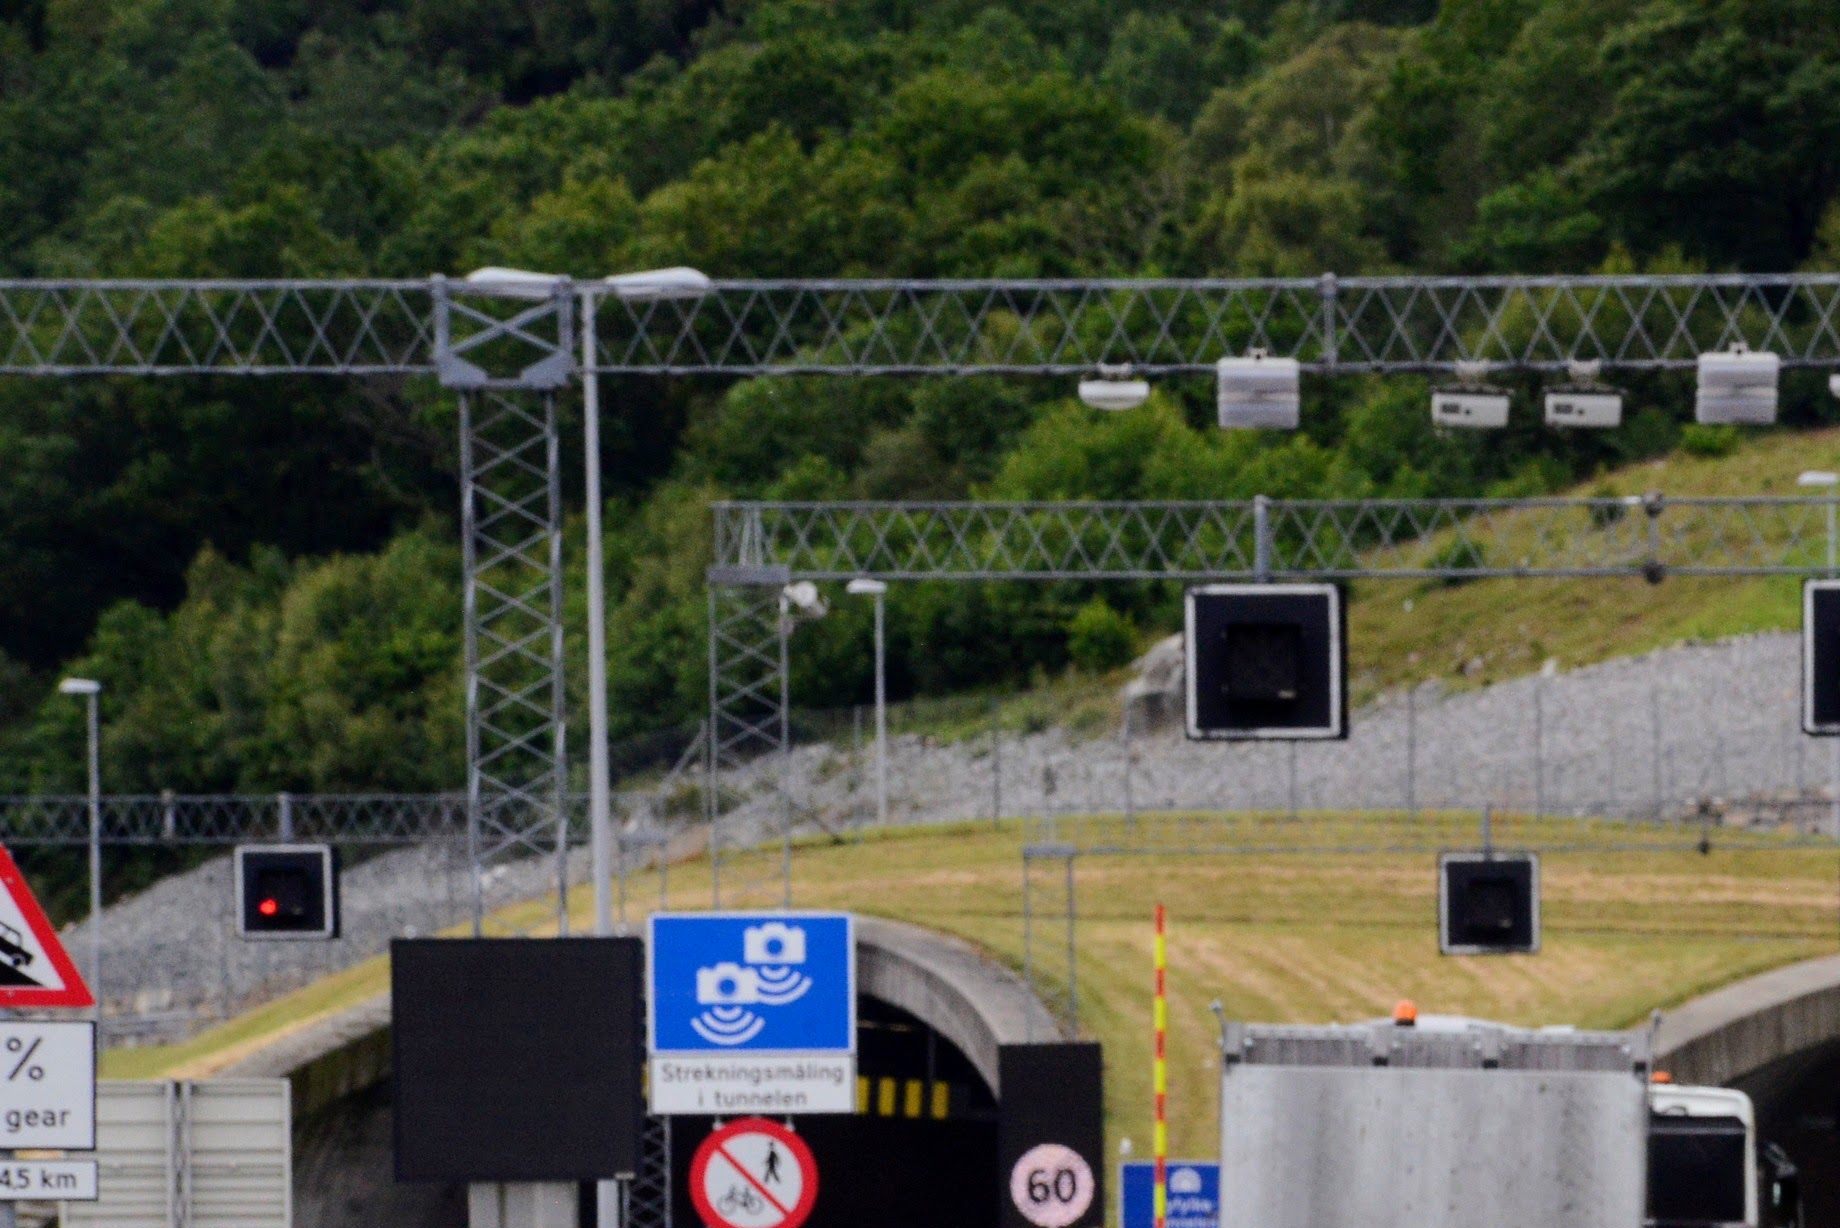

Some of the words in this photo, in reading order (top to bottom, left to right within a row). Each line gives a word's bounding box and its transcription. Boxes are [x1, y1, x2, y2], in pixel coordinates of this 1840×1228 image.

[661, 1062, 845, 1084] Strekningsmåling
[714, 1090, 808, 1106] tunnelen
[6, 1109, 71, 1133] gear
[40, 1168, 77, 1188] km
[1028, 1168, 1077, 1205] 60
